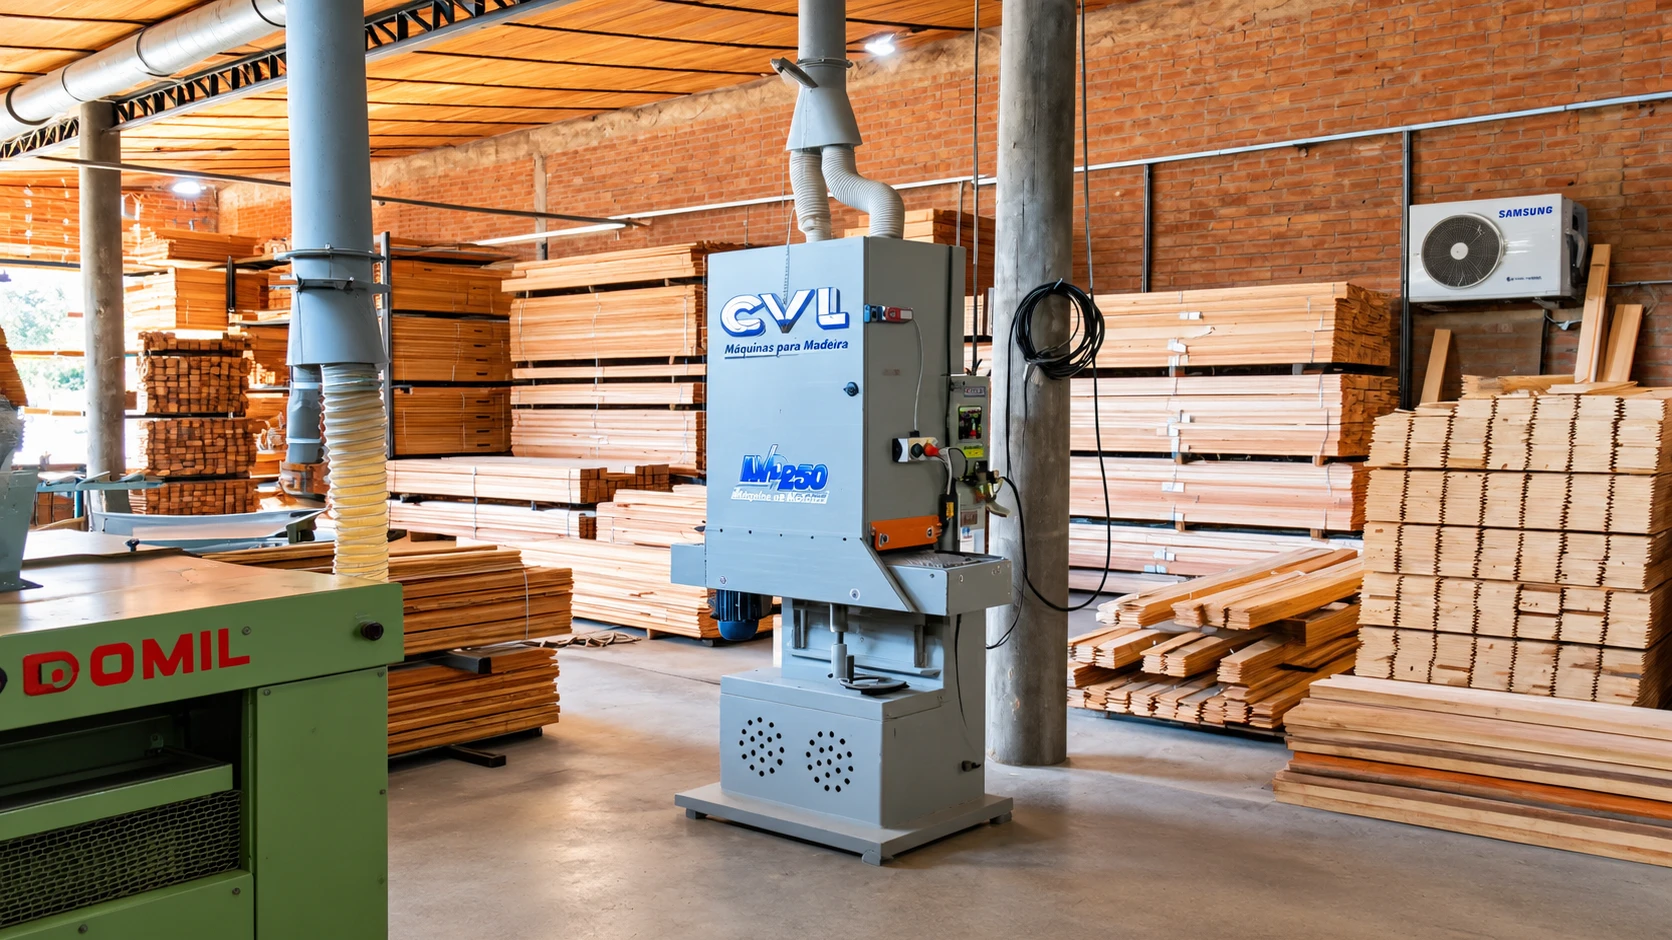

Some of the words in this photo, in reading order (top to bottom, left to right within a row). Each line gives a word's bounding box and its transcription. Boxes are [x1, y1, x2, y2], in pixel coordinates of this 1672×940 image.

[1498, 206, 1553, 218] SAMSUNG
[720, 287, 850, 338] CVL
[724, 342, 774, 359] Máquinas
[776, 343, 801, 358] para
[803, 338, 849, 351] Madeira
[22, 628, 251, 697] DOMIL
